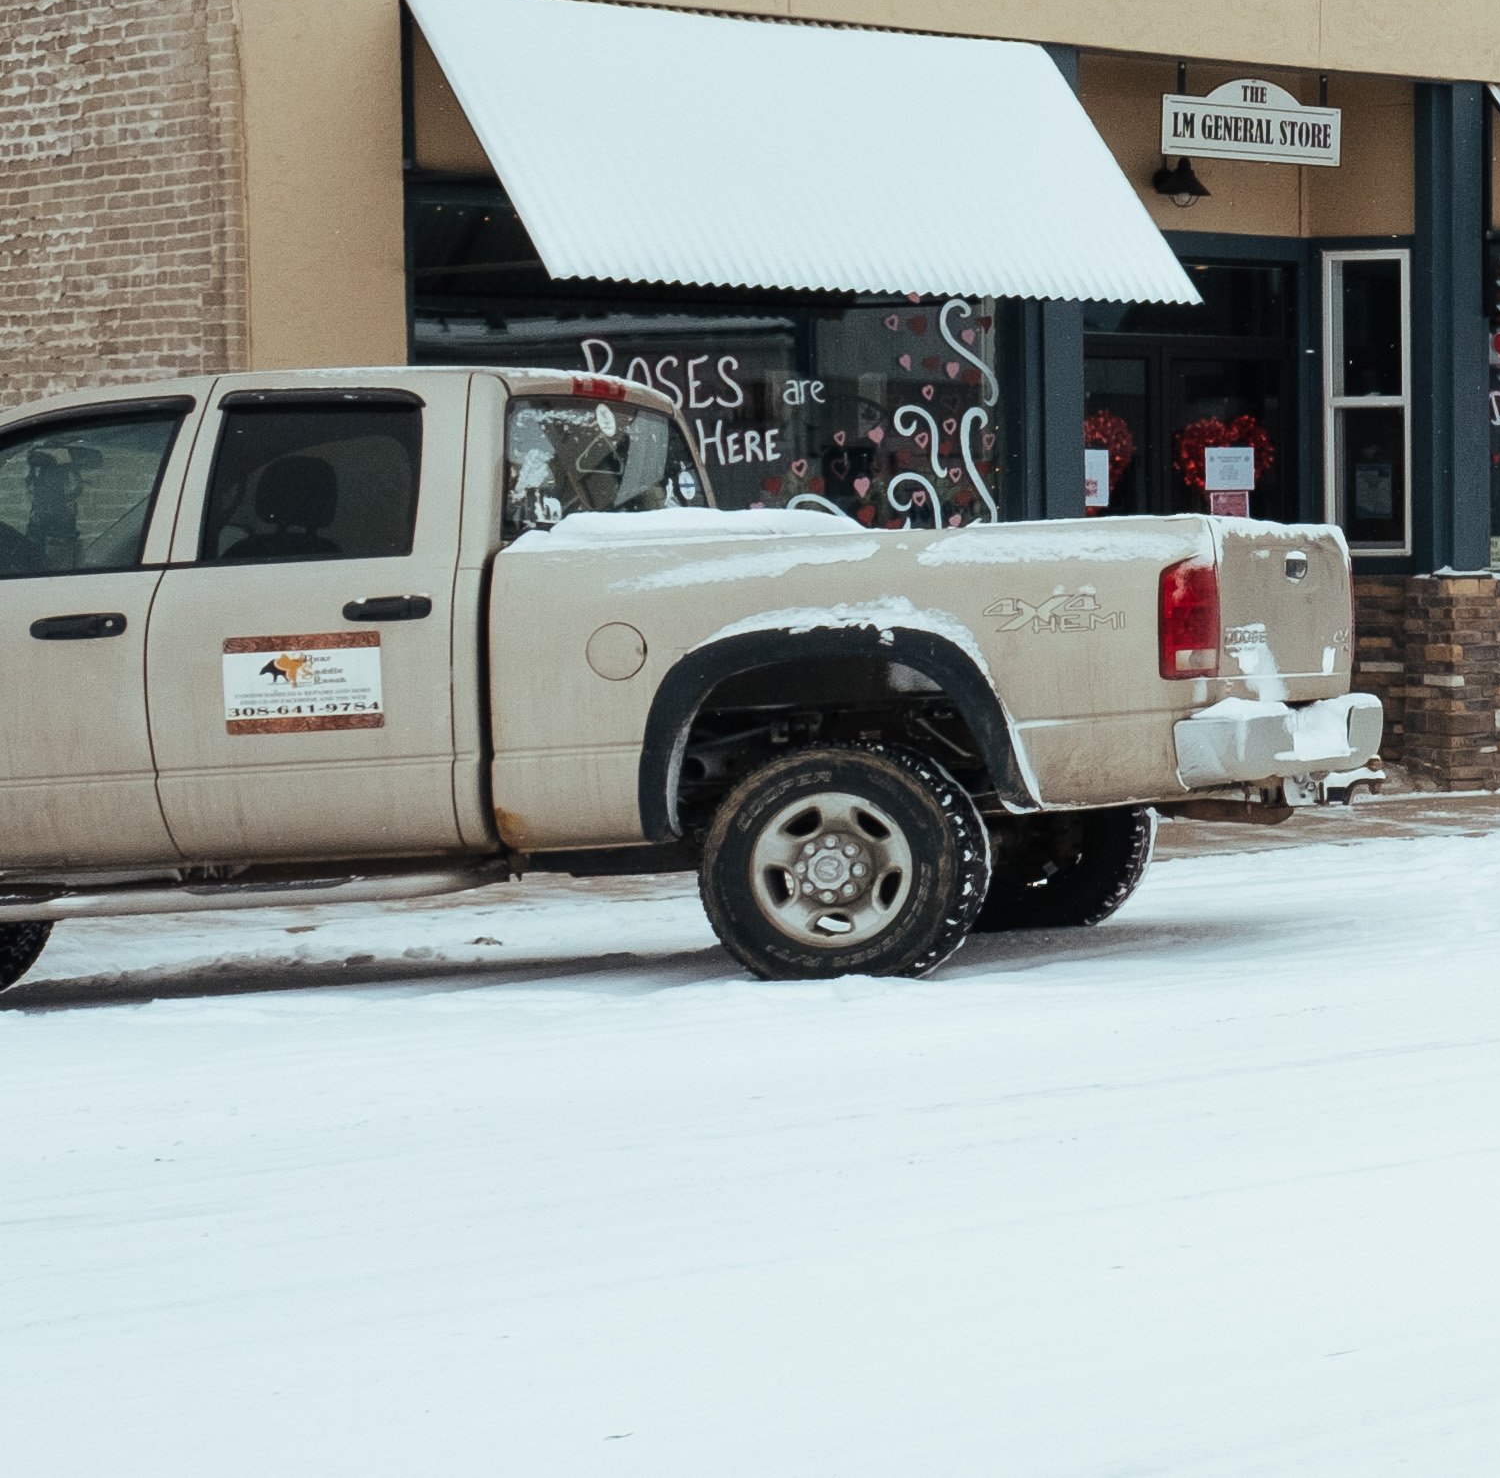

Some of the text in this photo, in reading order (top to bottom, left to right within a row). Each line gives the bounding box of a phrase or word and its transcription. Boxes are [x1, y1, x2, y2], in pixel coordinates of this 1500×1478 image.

[1241, 85, 1268, 104] THE
[1172, 111, 1332, 149] LM GENERAL STORE
[782, 379, 826, 405] are
[1033, 611, 1126, 634] HEMI
[228, 701, 380, 718] 308-641-9784
